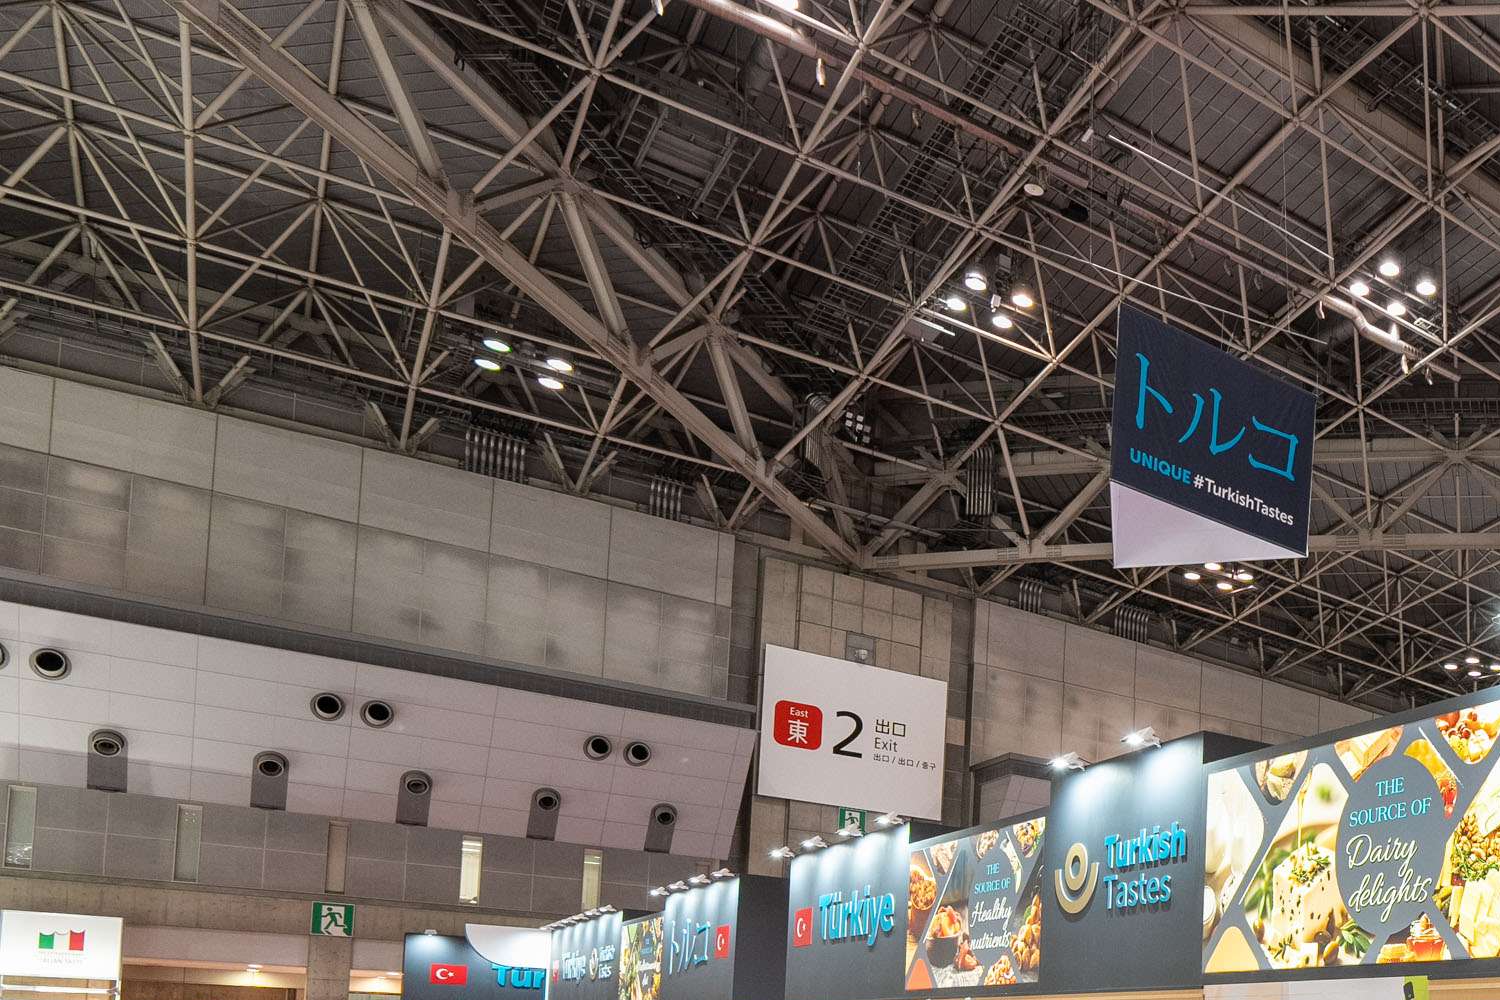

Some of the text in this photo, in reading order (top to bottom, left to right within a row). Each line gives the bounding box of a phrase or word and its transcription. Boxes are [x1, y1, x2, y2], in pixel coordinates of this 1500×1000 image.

[1135, 352, 1299, 482] トルコ
[1129, 447, 1294, 526] UNIQUE #TurkishTastes
[789, 706, 809, 718] East
[787, 719, 810, 745] 東
[832, 710, 864, 759] 2
[875, 718, 906, 738] 出口
[874, 737, 898, 753] Exit
[1376, 777, 1405, 797] THE
[1349, 797, 1432, 827] SOURCE OF
[1104, 821, 1187, 868] Turkish
[1346, 833, 1418, 877] Dairy
[986, 863, 1000, 875] THE
[974, 878, 1011, 894] SOURCE OF
[1103, 872, 1172, 910] Tastes
[1349, 868, 1433, 923] delights
[819, 885, 895, 946] Türkiye
[969, 897, 1012, 929] Healthy
[968, 931, 1012, 951] nutrients
